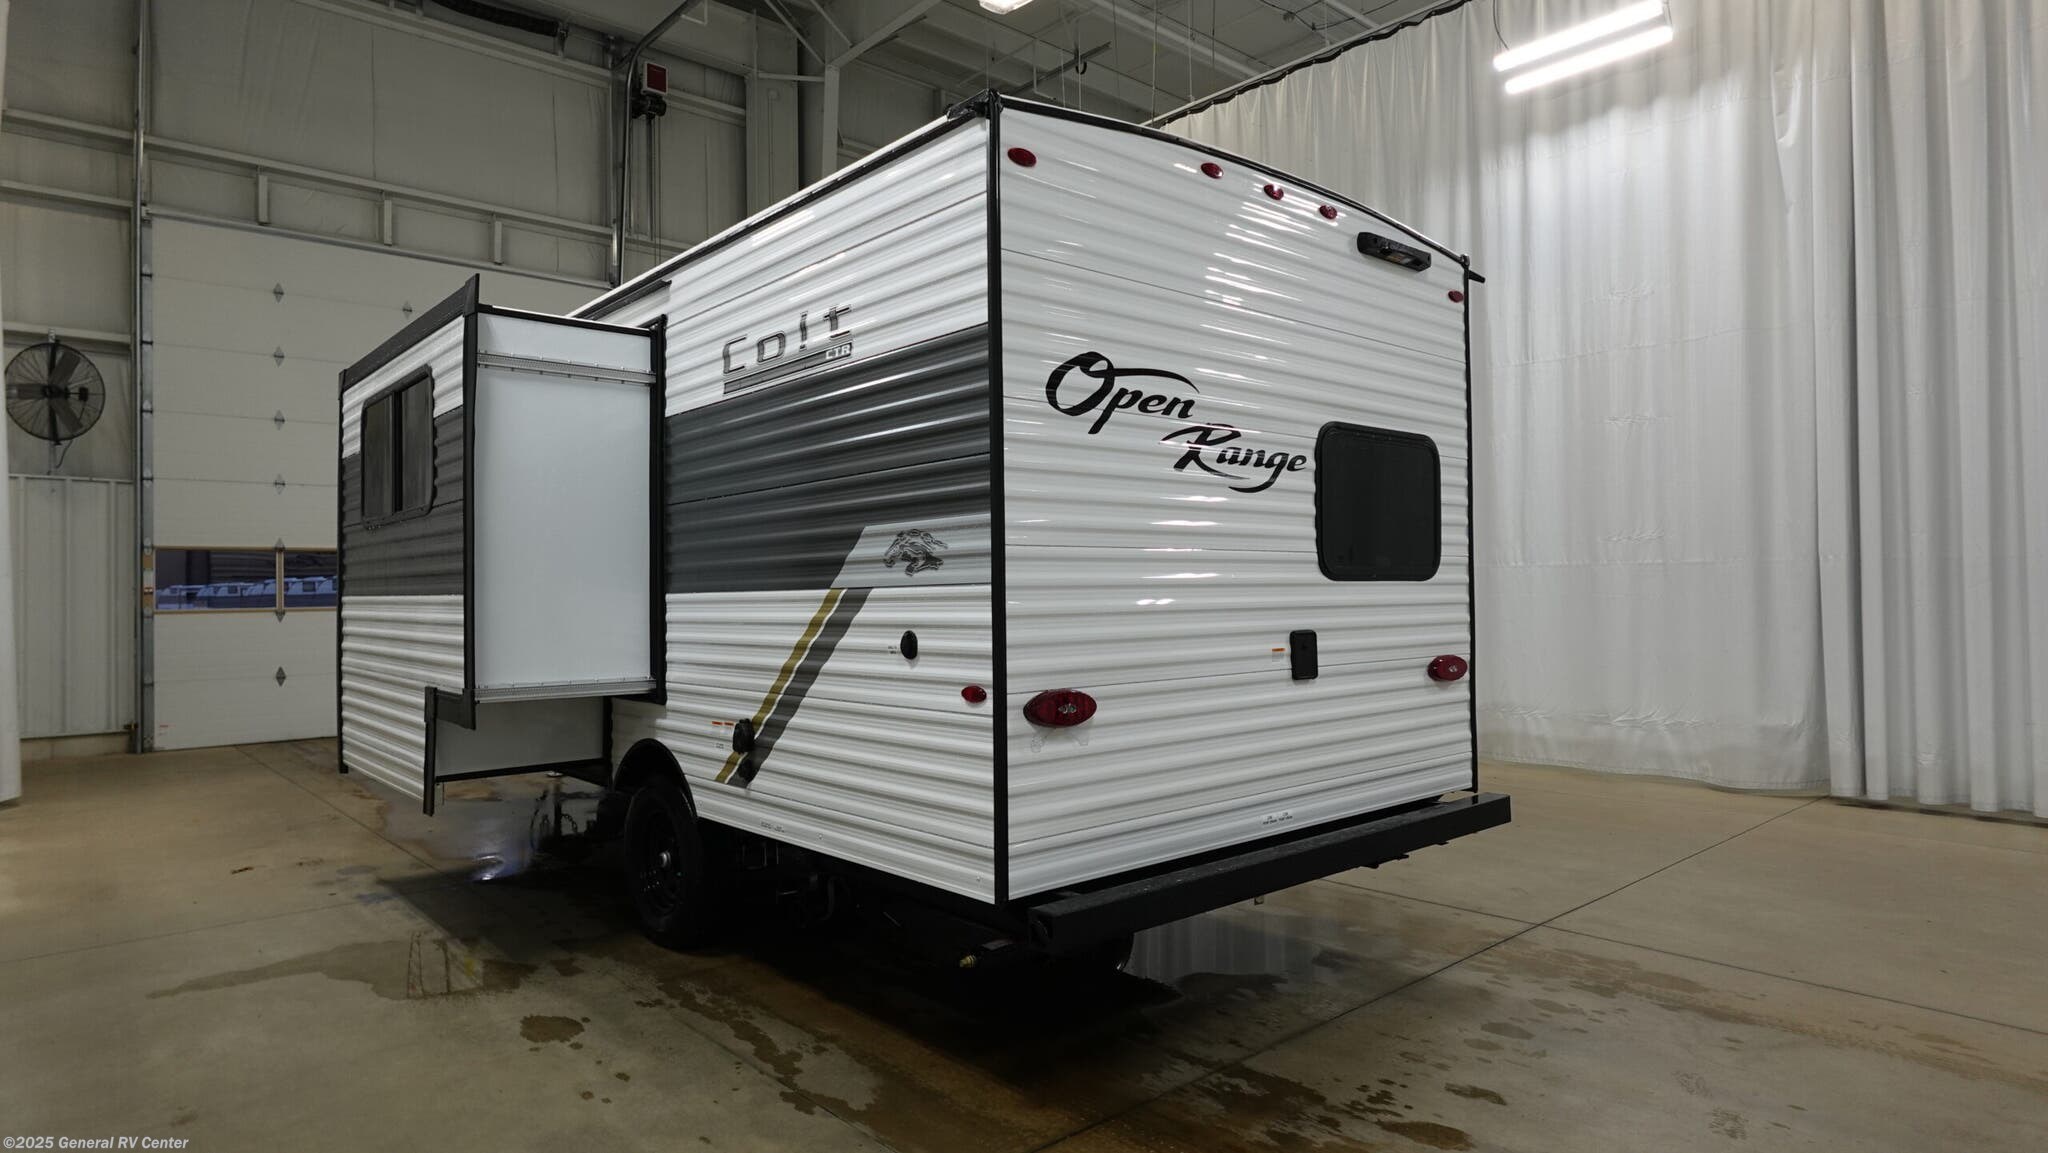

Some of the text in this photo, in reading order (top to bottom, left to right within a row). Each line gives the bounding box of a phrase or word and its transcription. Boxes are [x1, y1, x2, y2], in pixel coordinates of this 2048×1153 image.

[825, 345, 851, 360] CTR
[1045, 351, 1199, 434] Open
[1159, 422, 1307, 493] Range
